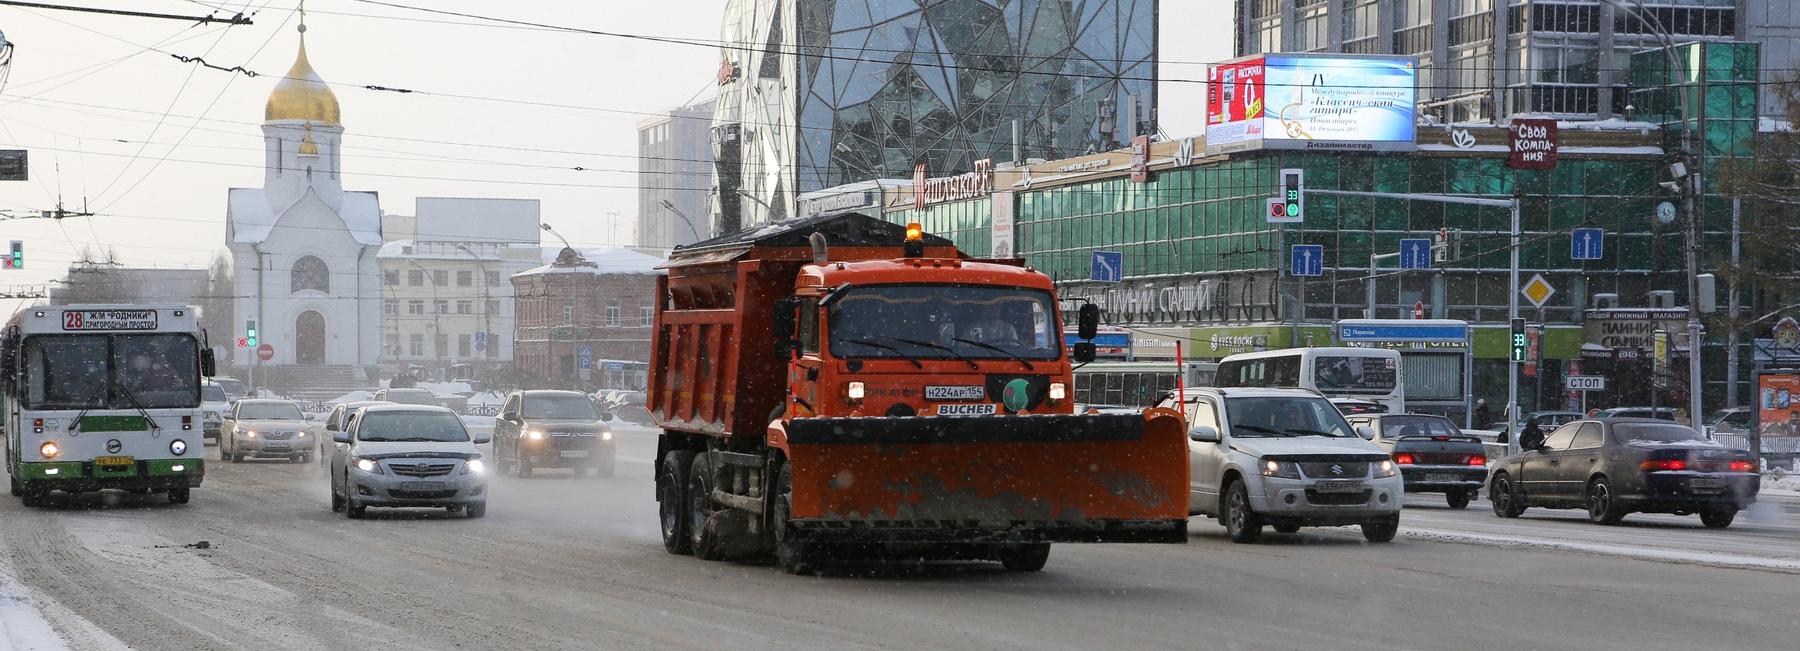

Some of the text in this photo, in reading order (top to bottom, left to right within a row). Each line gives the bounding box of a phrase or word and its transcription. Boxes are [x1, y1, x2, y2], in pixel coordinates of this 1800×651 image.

[1310, 96, 1394, 108] «Классичская
[1307, 141, 1373, 150] Дизайнмастер
[1288, 190, 1297, 200] 33
[1108, 283, 1155, 314] ПЛИНИЙ
[1159, 279, 1211, 312] СТАРШИЙ
[66, 312, 83, 328] 28
[1613, 312, 1648, 320] КНИЖНЫЙ
[129, 321, 155, 329] ПРОСТОР
[1514, 334, 1525, 346] 33
[1570, 378, 1599, 387] СТОП
[967, 387, 983, 395] 154
[940, 405, 993, 414] BUCHER
